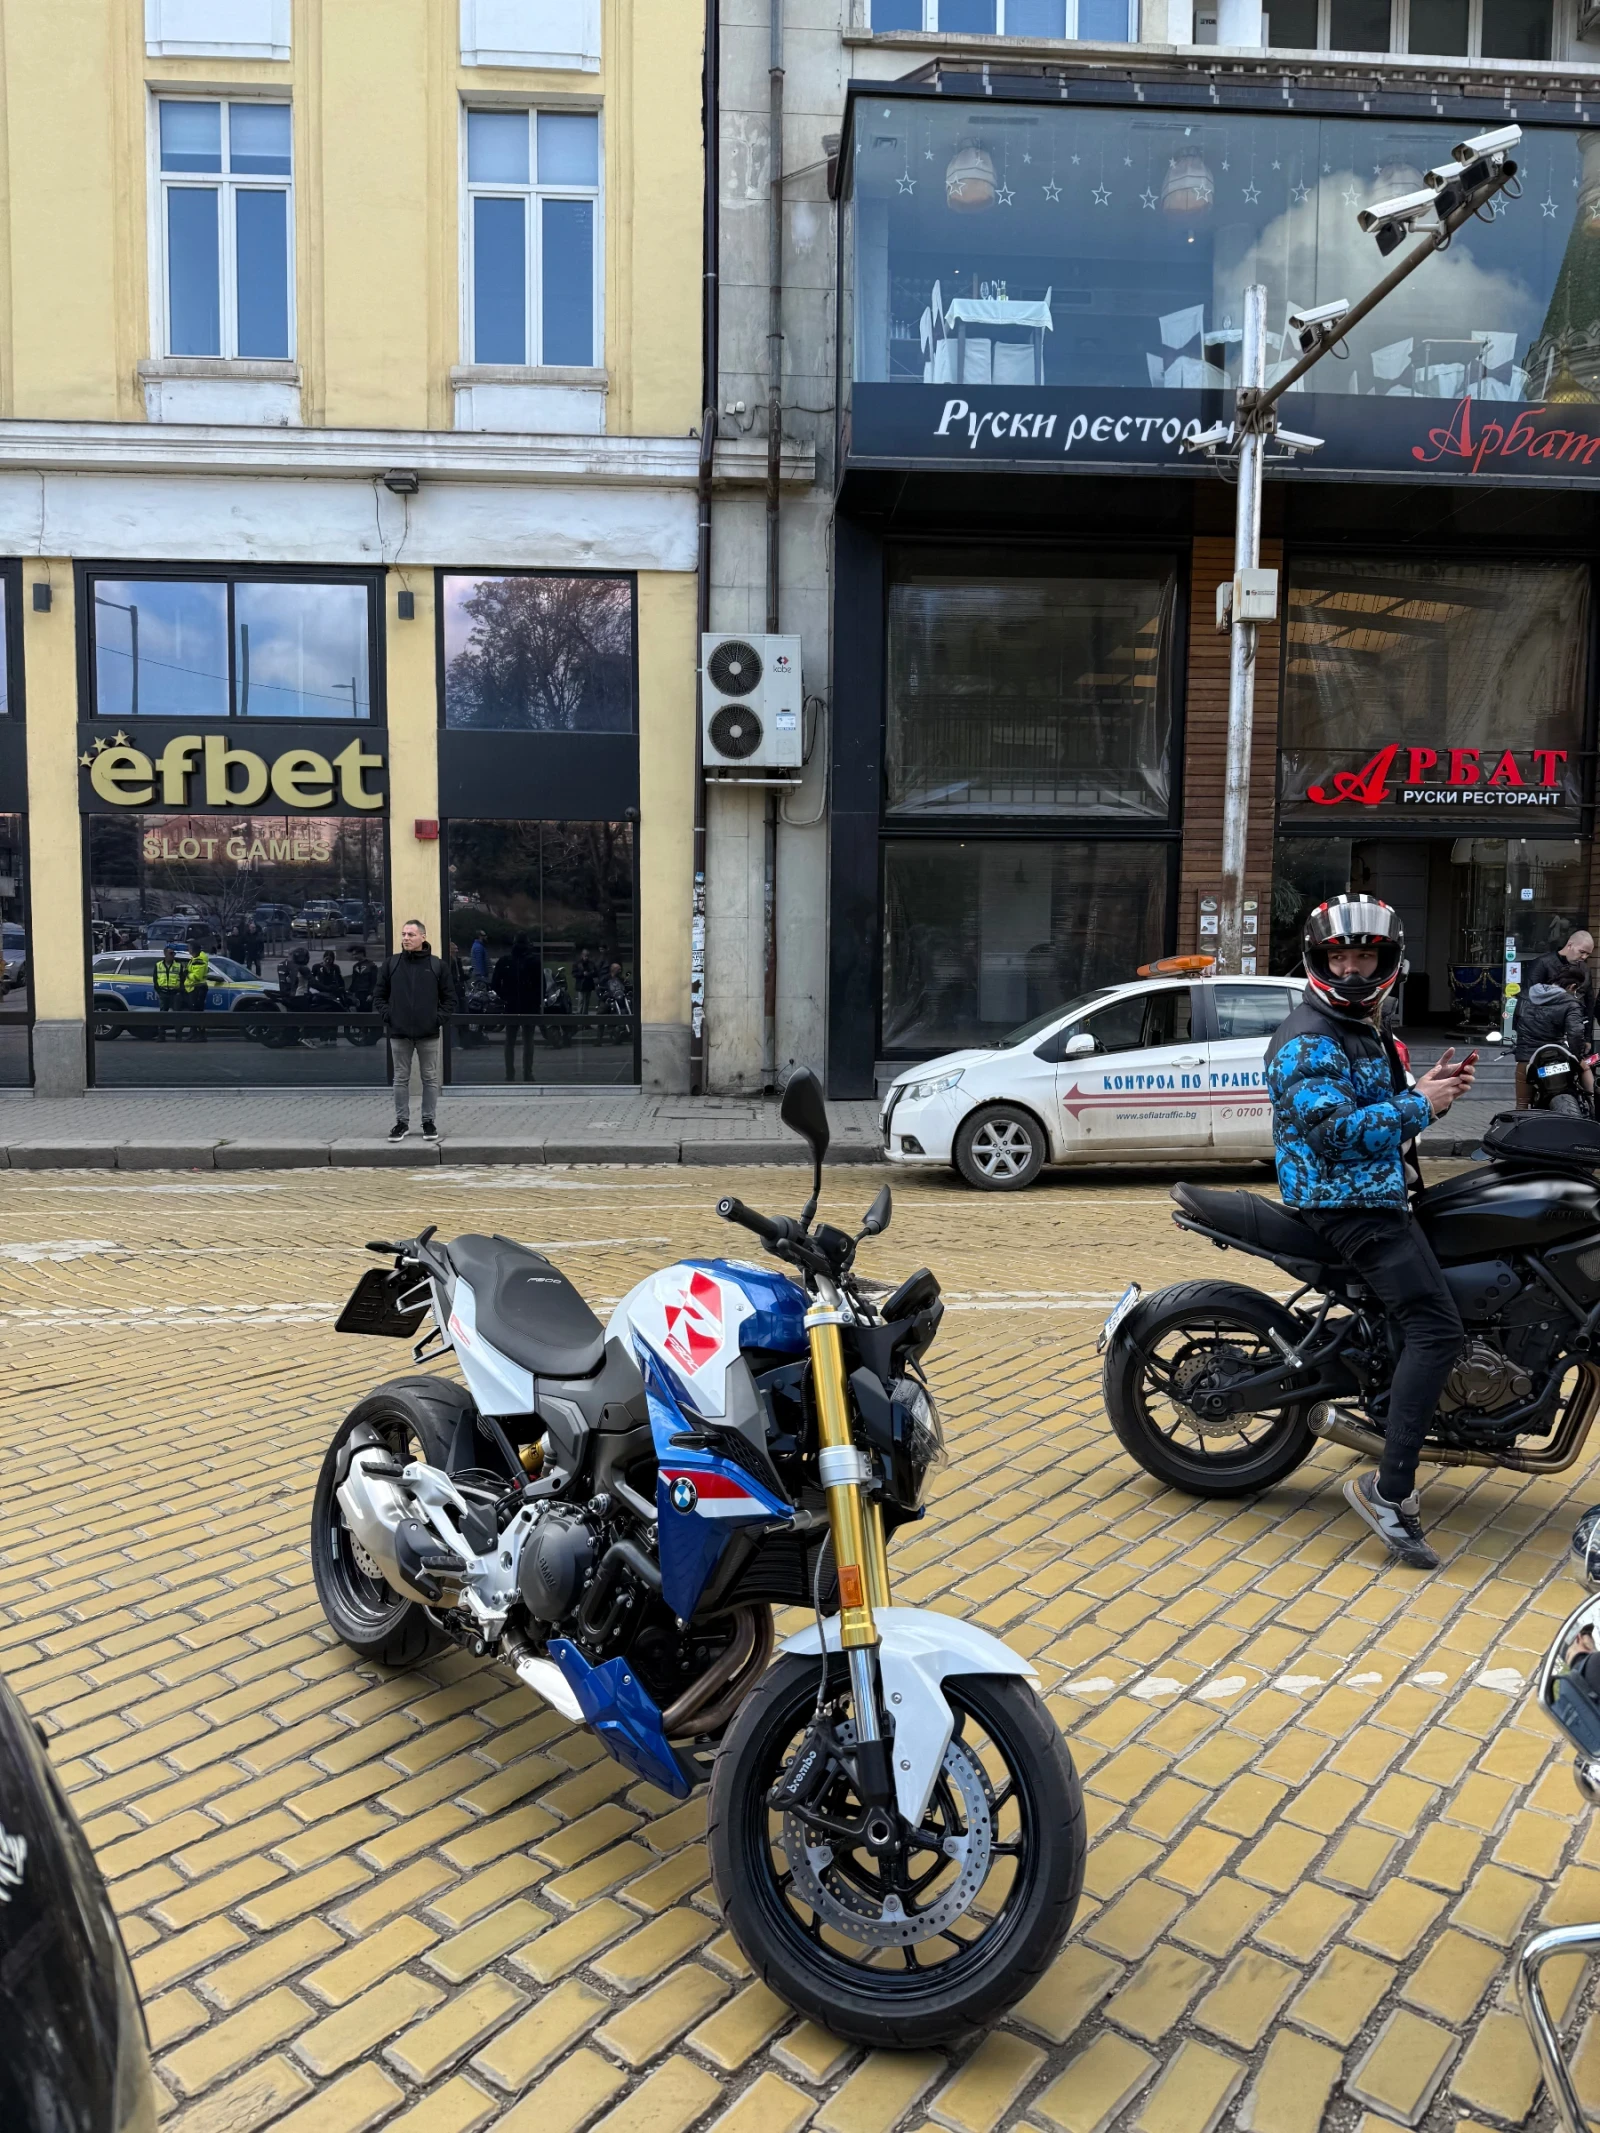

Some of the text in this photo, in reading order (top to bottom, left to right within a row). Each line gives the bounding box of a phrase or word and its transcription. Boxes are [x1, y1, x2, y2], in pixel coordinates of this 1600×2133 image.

[933, 399, 1283, 455] Руски рестор
[1411, 394, 1600, 474] Арбат
[90, 735, 385, 811] efbet
[1307, 743, 1568, 806] АРБАТ
[1403, 790, 1561, 805] РУСКИ РЕСТОРАНТ
[142, 837, 330, 862] SLOT GAMES
[1103, 1075, 1175, 1090] КОНТРОЛ
[1181, 1074, 1201, 1089] ПО
[1116, 1110, 1197, 1120] www.sofiatraffic.bg
[1236, 1107, 1263, 1117] 0700
[786, 1750, 817, 1794] brembo
